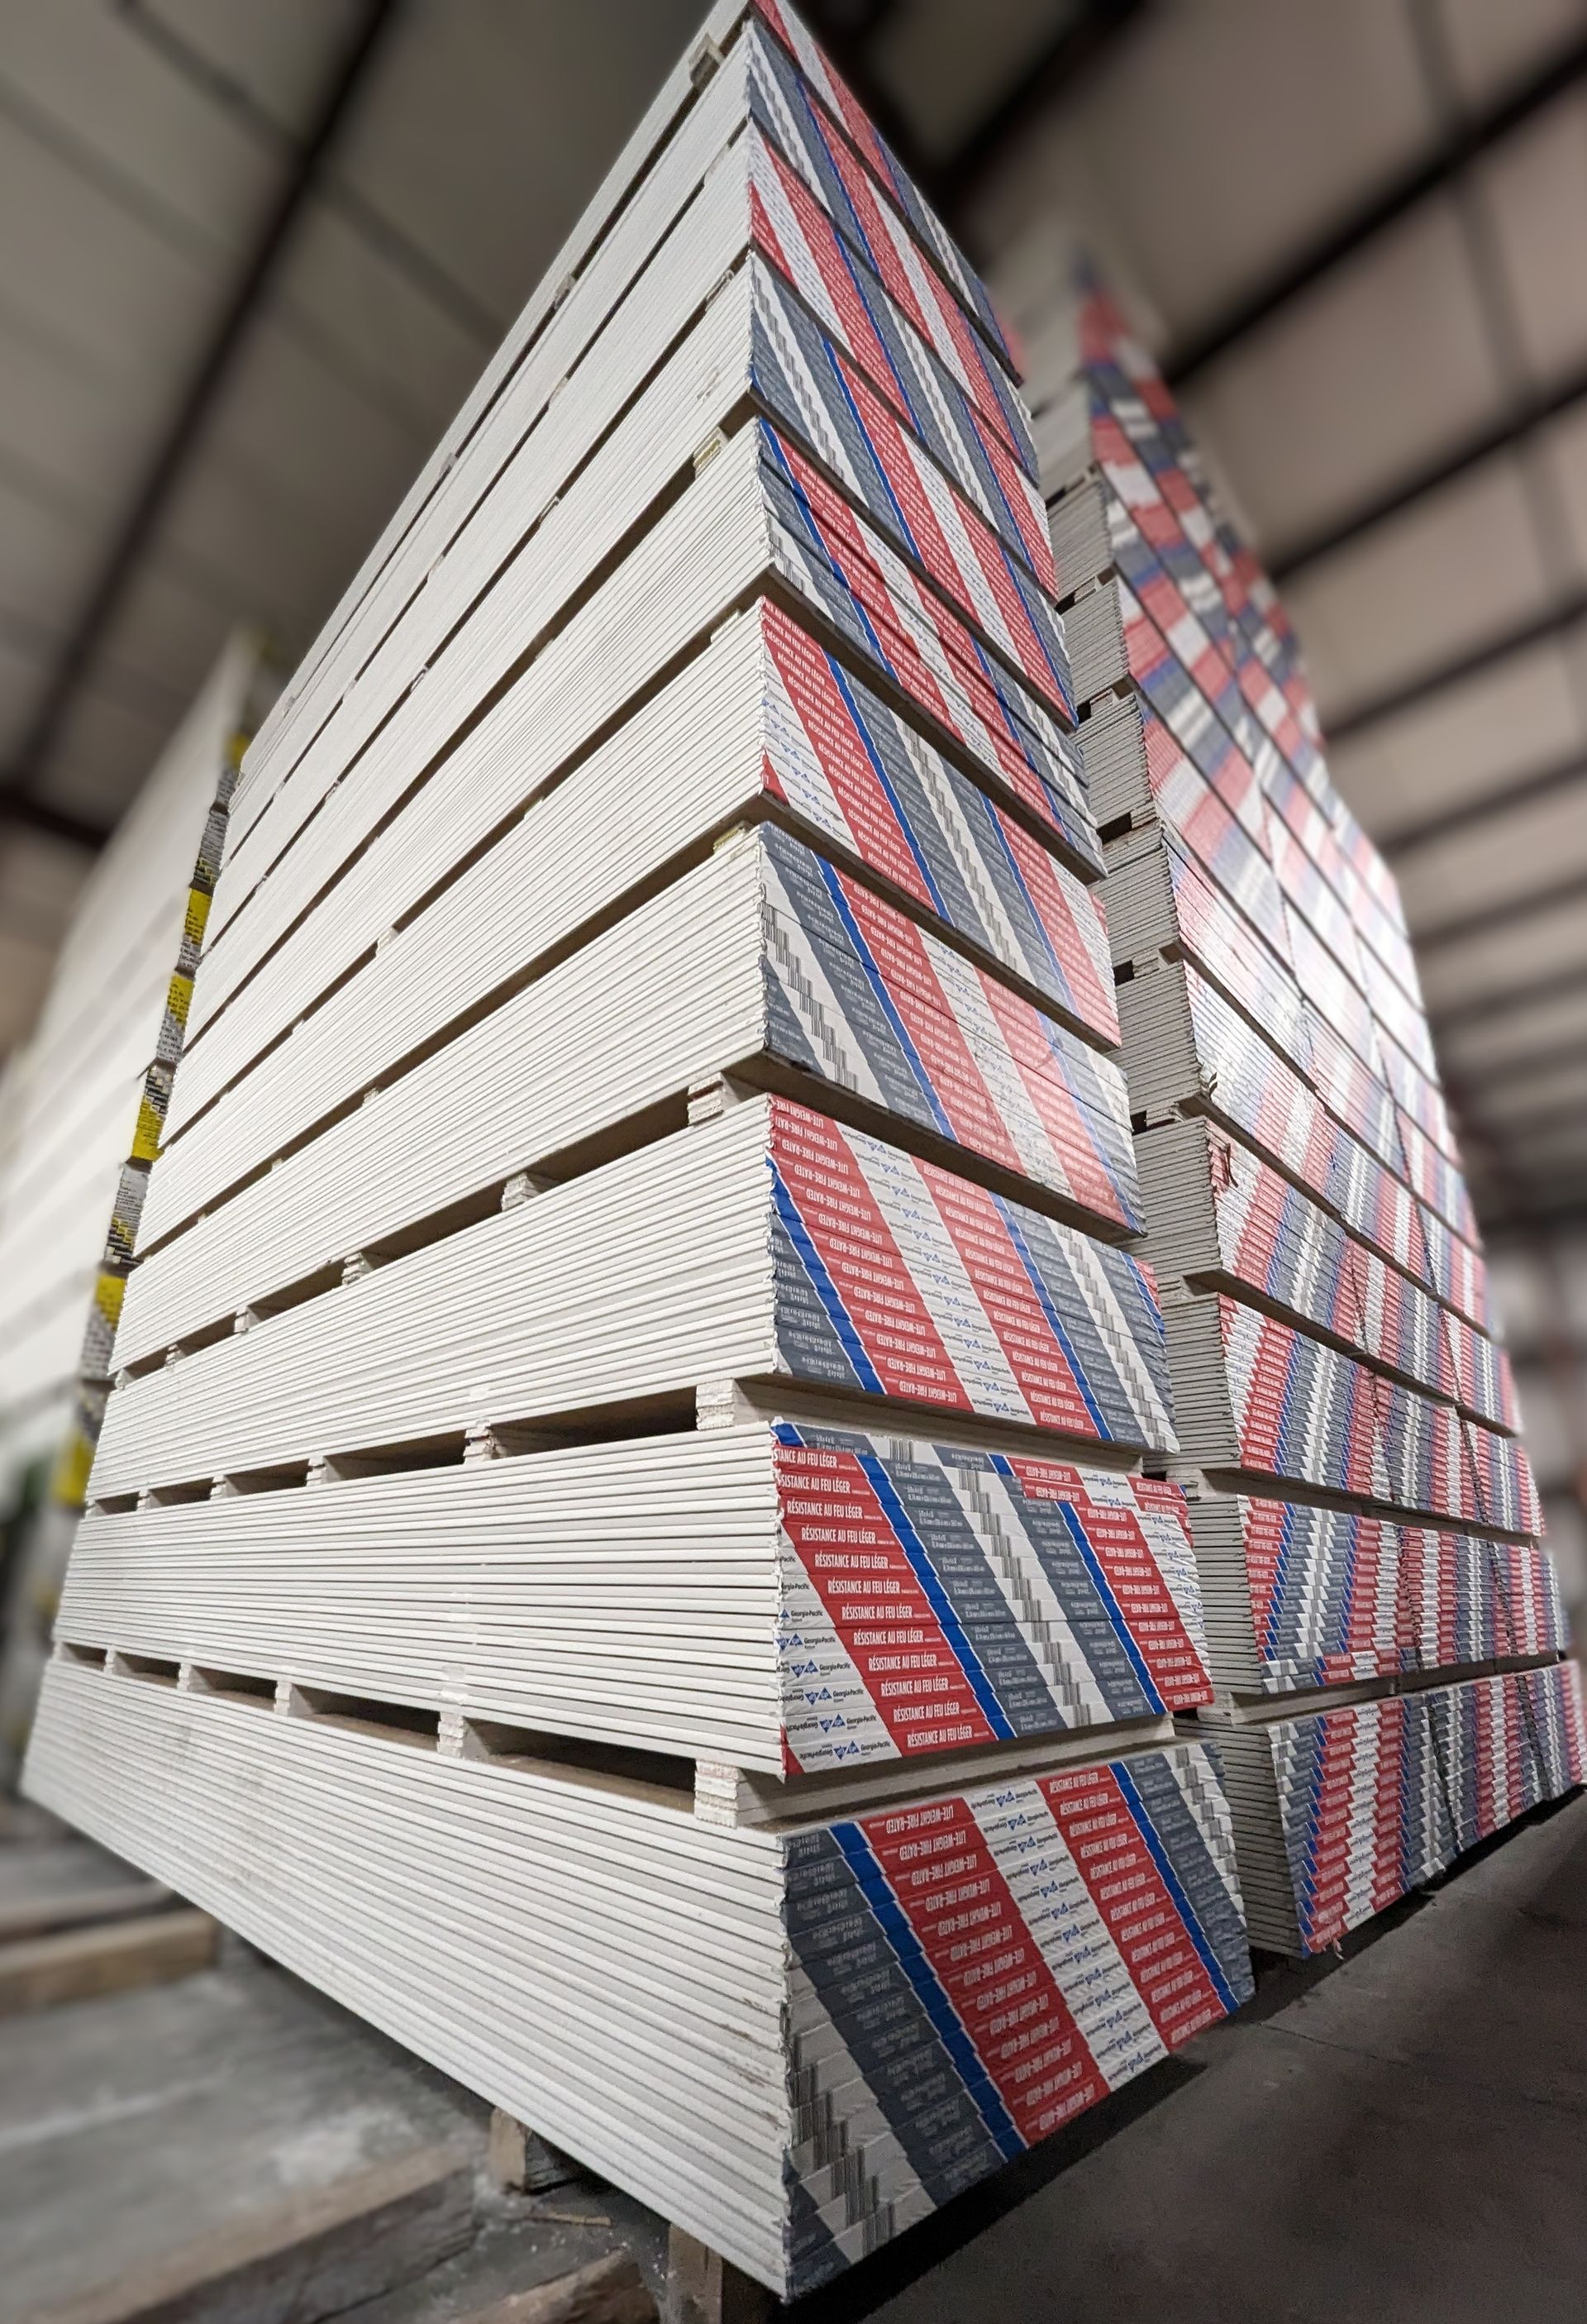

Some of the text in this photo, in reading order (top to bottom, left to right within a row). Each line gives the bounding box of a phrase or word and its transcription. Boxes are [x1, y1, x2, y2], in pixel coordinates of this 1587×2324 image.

[797, 1451, 806, 1464] AU
[808, 1453, 818, 1467] FEU
[819, 1452, 837, 1468] LÉGER
[811, 1477, 819, 1491] AU
[821, 1478, 832, 1491] FEU
[832, 1477, 851, 1494] LÉGER
[787, 1497, 863, 1519] RÉSISTANCE AU FEU LÉGER
[802, 1524, 876, 1544] RÉSISTANCE AU FEU LÉGER
[815, 1550, 889, 1569] RÉSISTANCE AU FEU LÉGER
[827, 1577, 900, 1594] RÉSISTANCE AU FEU LÉGER
[841, 1603, 913, 1620] RÉSISTANCE AU FEU LÉGER
[854, 1627, 923, 1645] RÉSISTANCE AU FEU LÉGER
[869, 1651, 937, 1671] RÉSISTANCE AU FEU LÉGER
[881, 1675, 949, 1696] RÉSISTANCE AU FEU LÉGER
[894, 1701, 960, 1723] RÉSISTANCE AU FEU LÉGER
[908, 1724, 972, 1748] RÉSISTANCE AU FEU LÉGER
